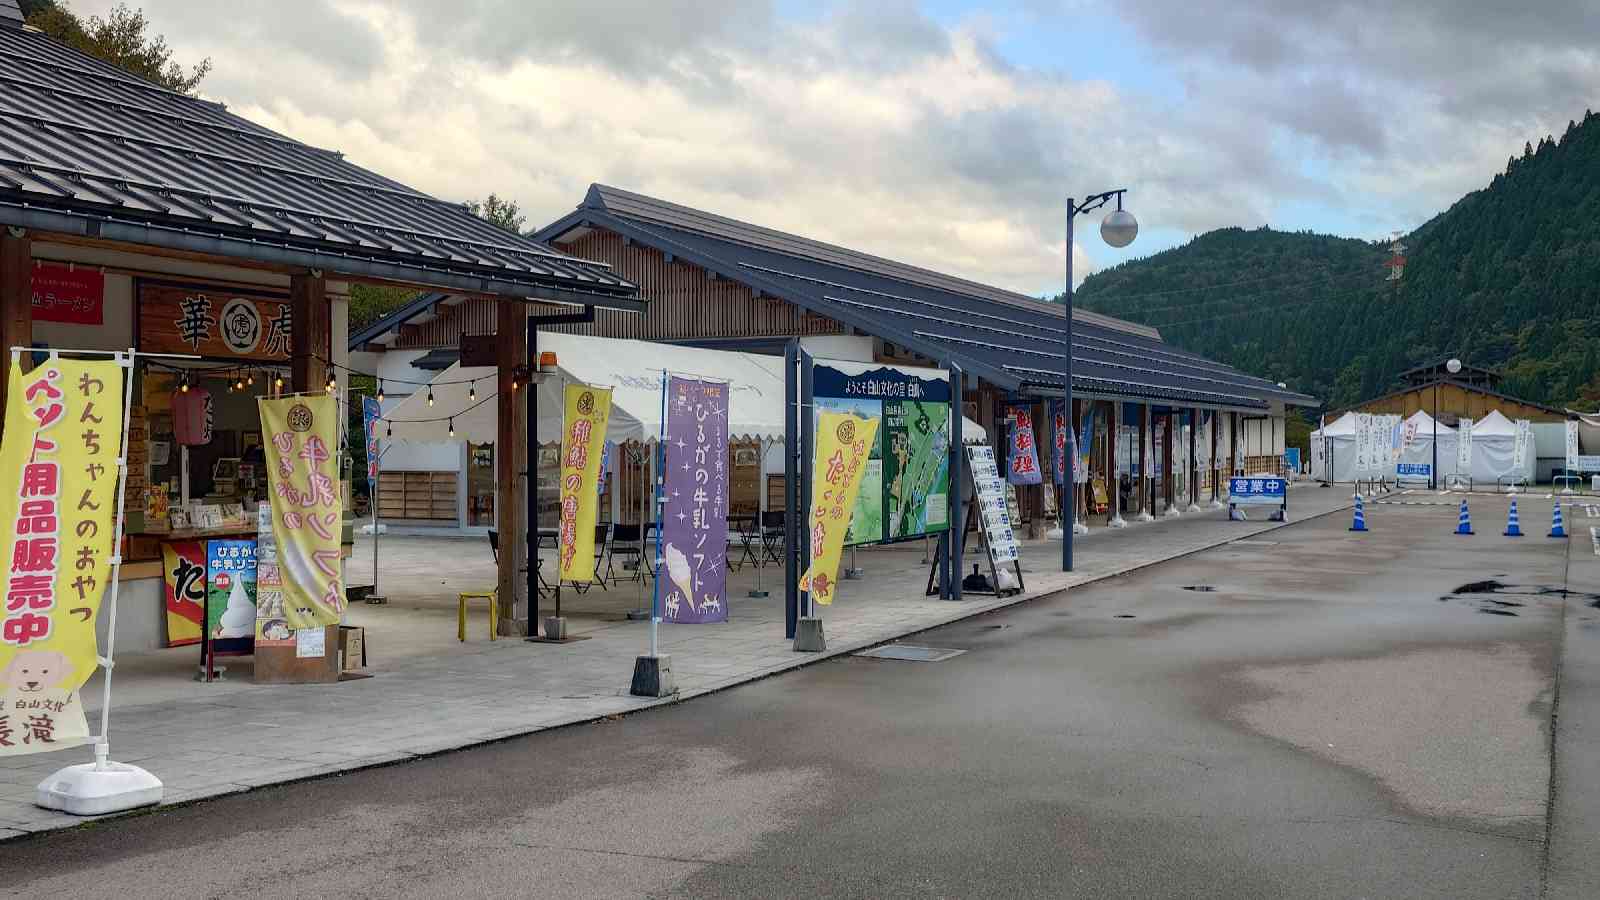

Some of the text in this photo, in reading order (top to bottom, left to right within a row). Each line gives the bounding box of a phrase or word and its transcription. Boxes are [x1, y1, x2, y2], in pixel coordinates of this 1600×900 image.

[175, 294, 215, 352] 華
[3, 370, 63, 644] ペット用品販売中
[70, 373, 105, 622] わんちゃんのおやつ
[693, 403, 710, 592] ひるがの牛乳ソフト
[1234, 479, 1280, 493] 営業中
